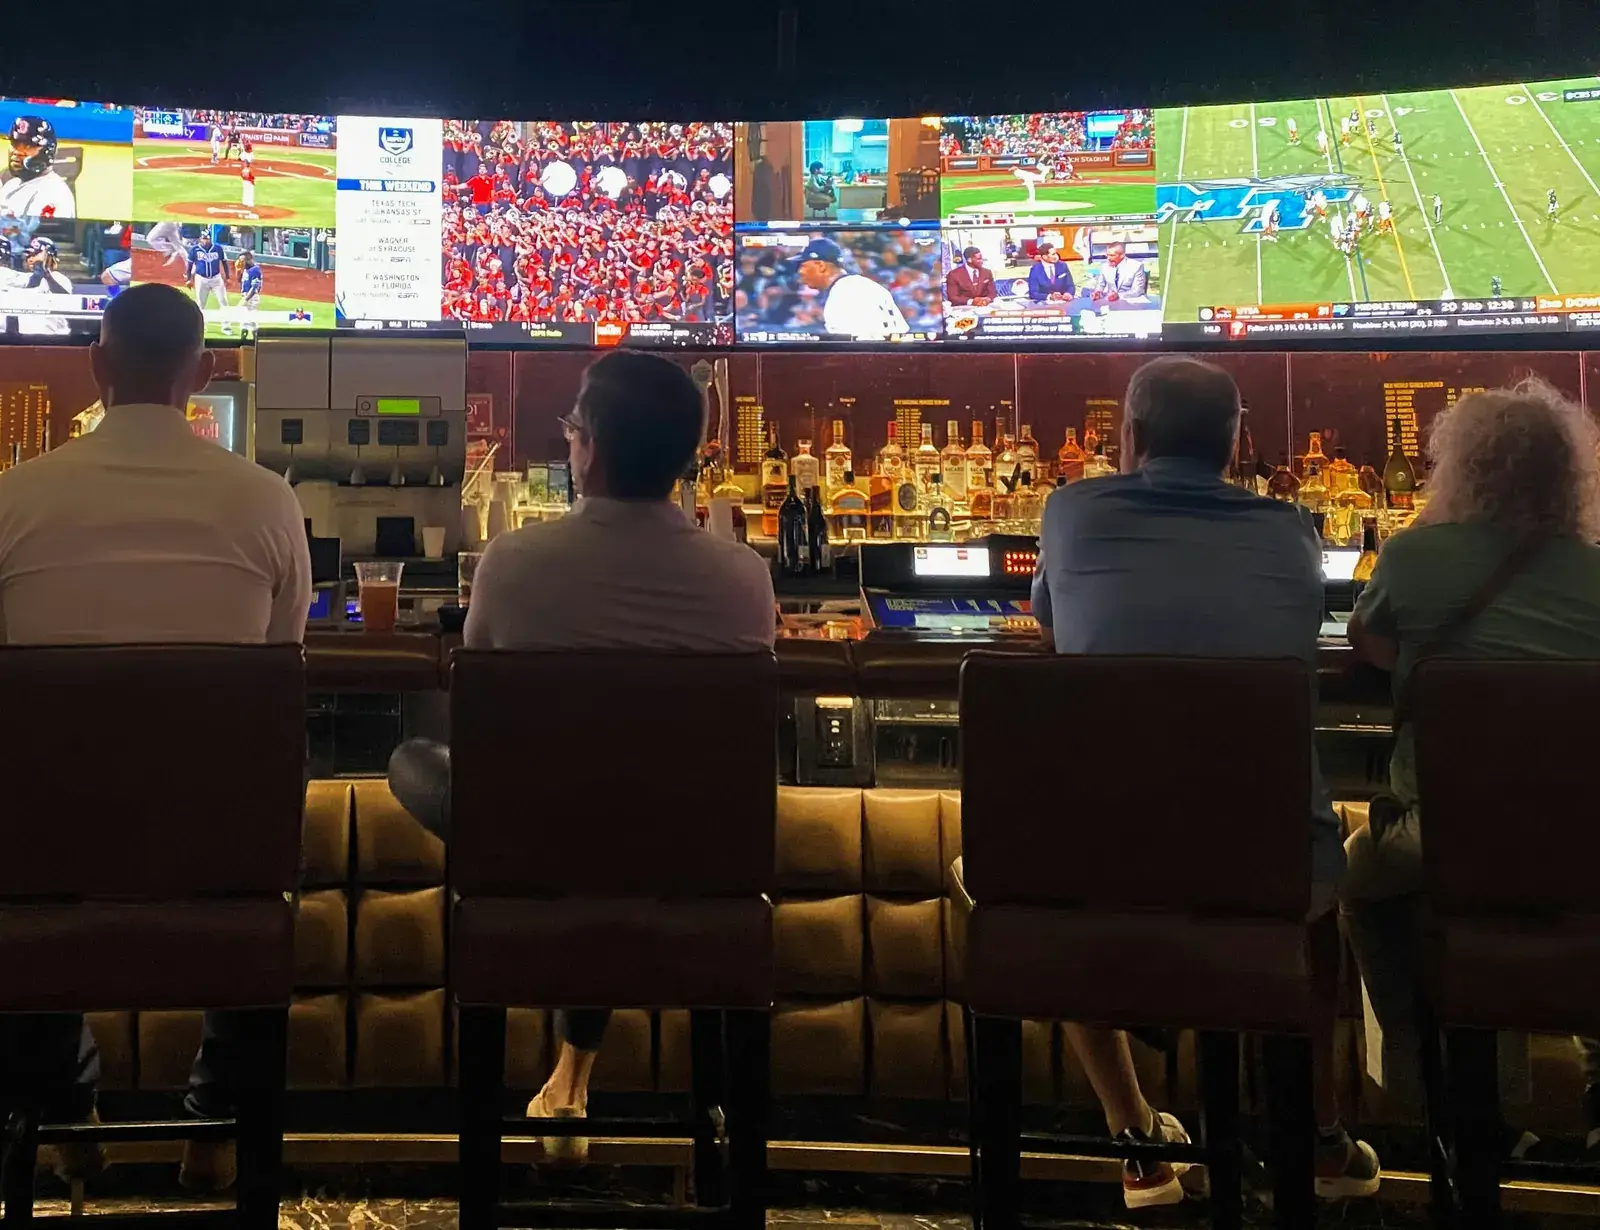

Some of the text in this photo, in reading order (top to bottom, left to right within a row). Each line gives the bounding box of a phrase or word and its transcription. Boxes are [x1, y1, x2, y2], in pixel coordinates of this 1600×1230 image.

[379, 156, 411, 164] COLLEGE
[384, 180, 432, 192] WEEKEND
[378, 245, 416, 253] SYRACUSE
[381, 282, 412, 290] FLORIDA
[1441, 301, 1458, 312] 20
